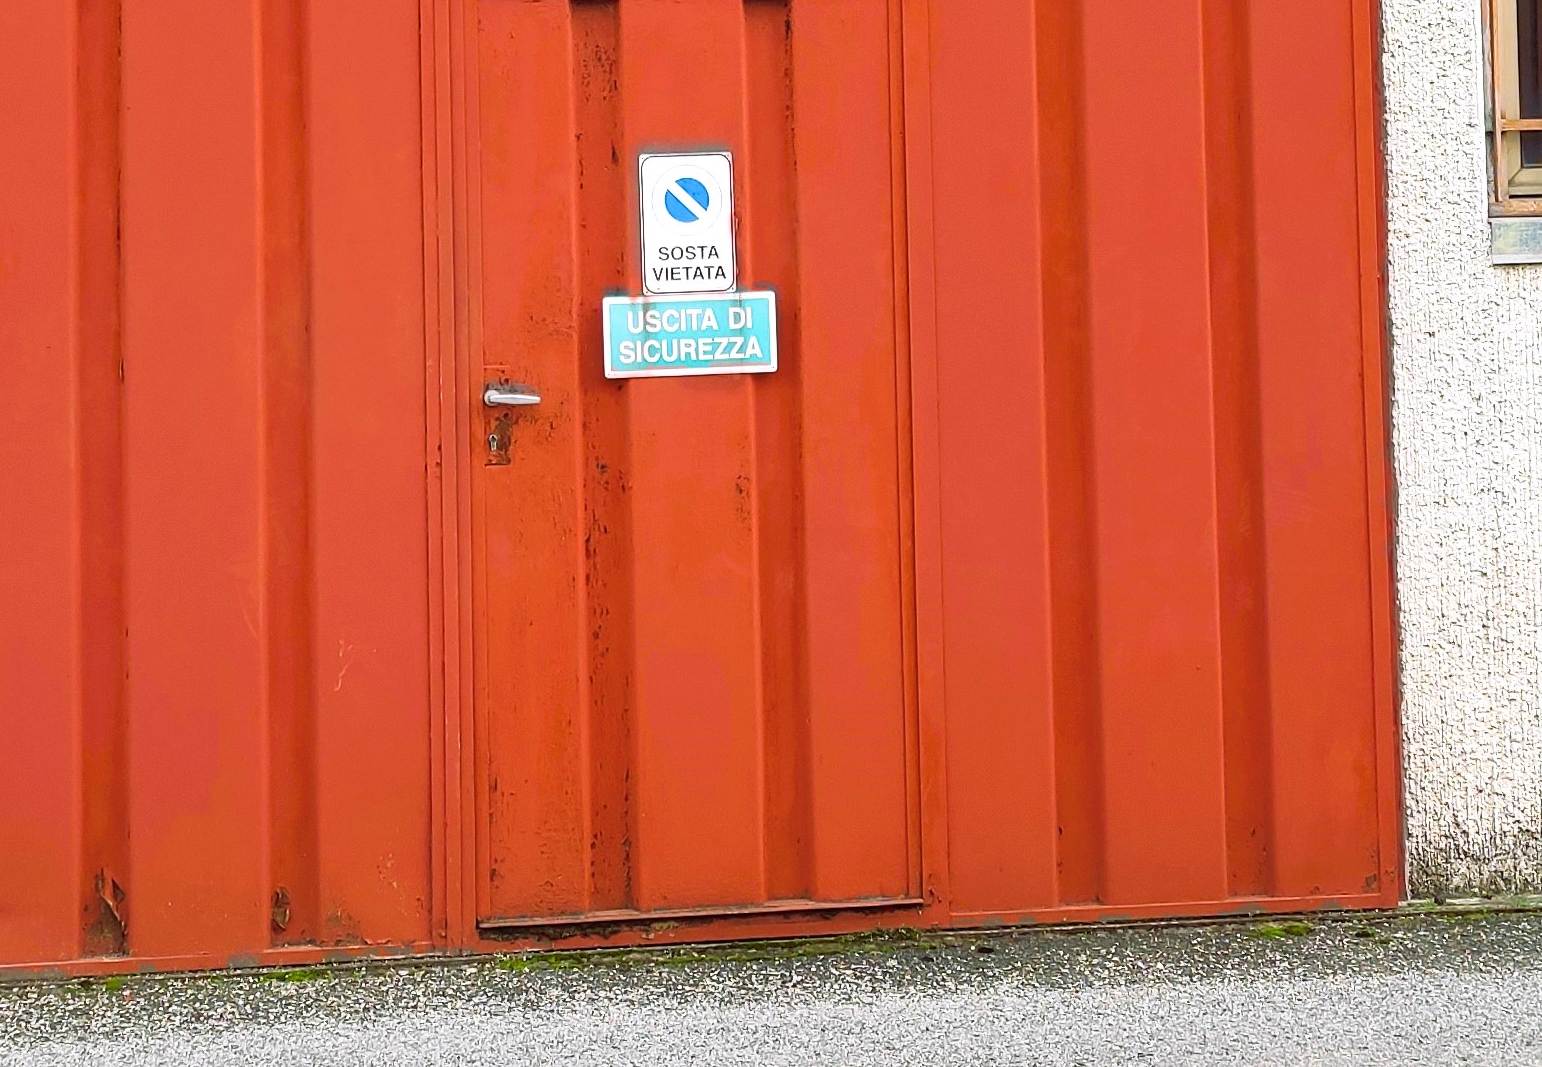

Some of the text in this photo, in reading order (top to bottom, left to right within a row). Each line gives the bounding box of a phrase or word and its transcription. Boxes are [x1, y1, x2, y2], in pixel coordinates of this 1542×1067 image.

[658, 245, 719, 261] SOSTA
[652, 265, 726, 281] VIETATA
[627, 307, 753, 334] USCITA DI
[619, 335, 763, 364] SICUREZZA
